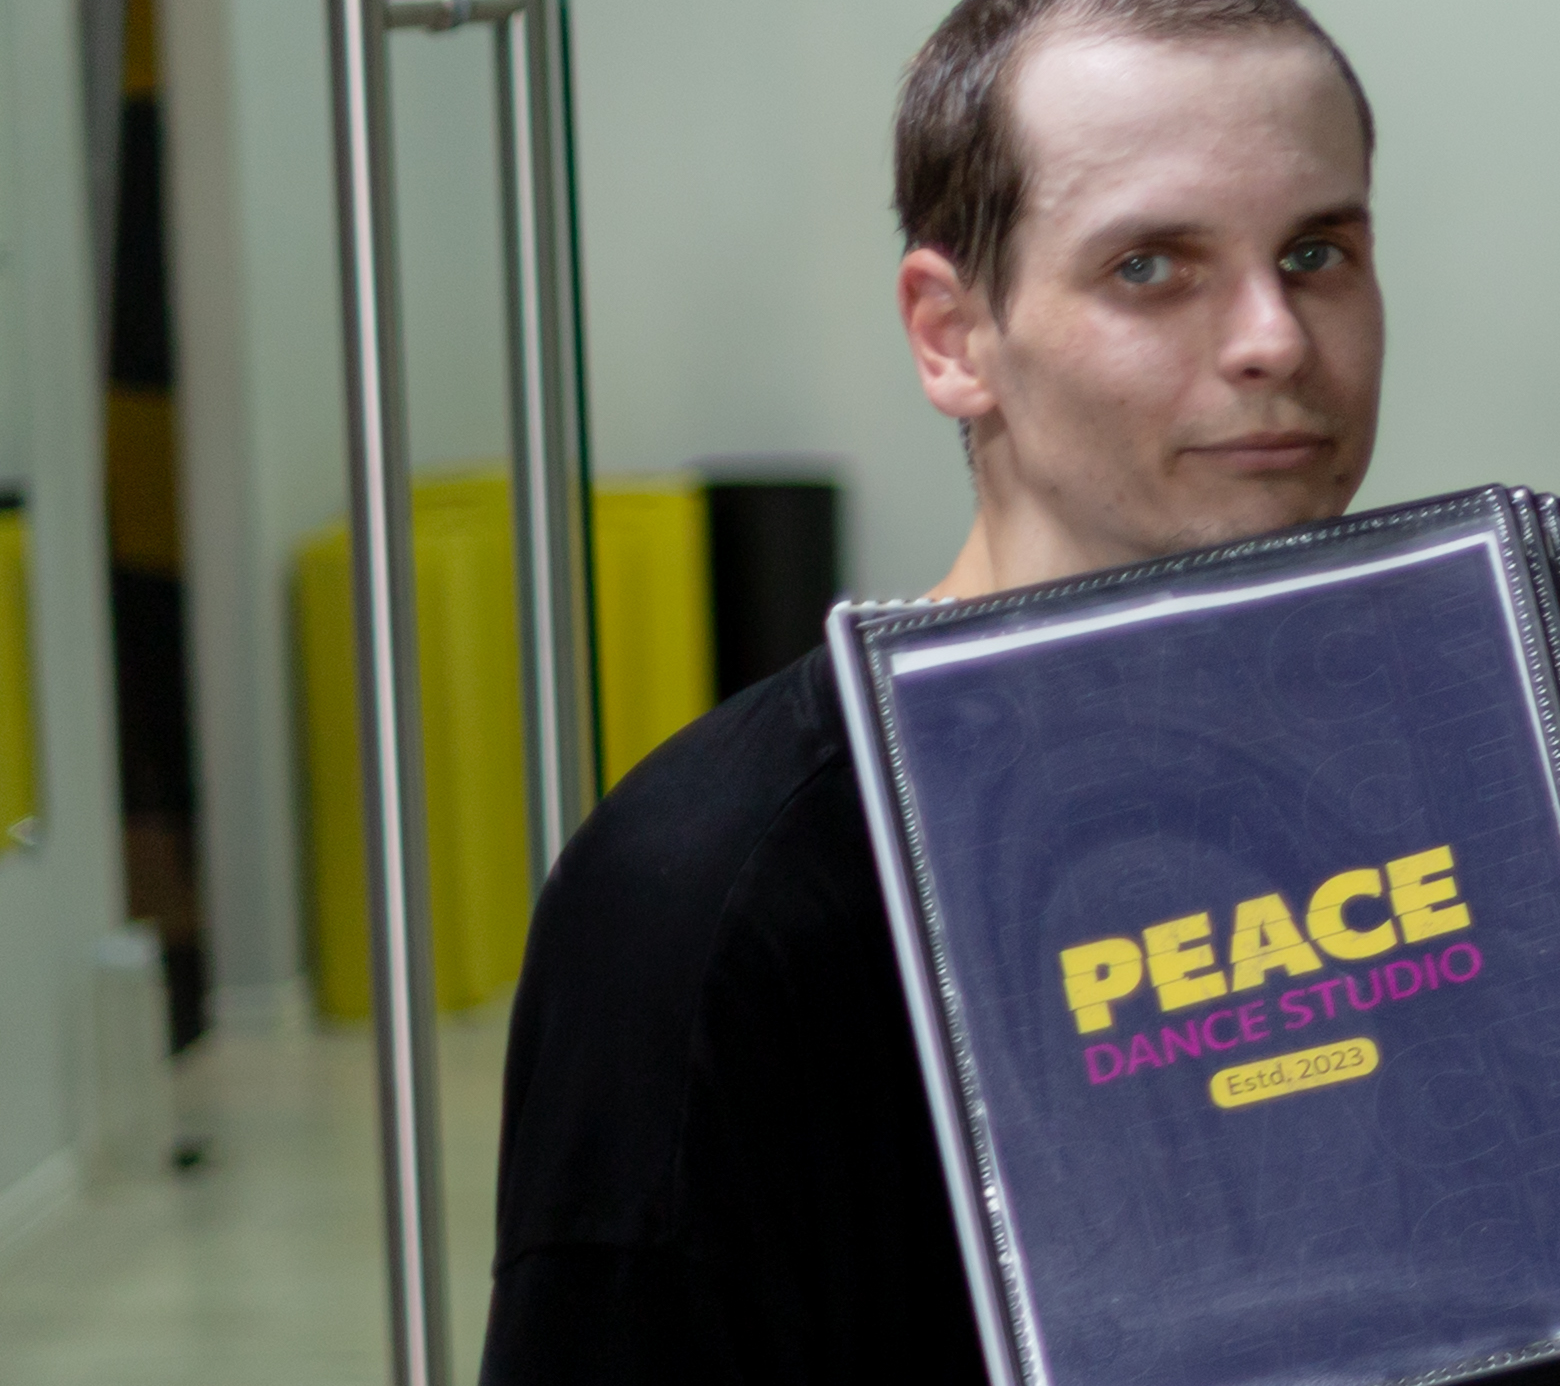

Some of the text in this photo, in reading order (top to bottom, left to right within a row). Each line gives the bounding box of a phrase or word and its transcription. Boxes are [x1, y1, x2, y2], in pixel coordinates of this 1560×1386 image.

[1058, 844, 1471, 1035] PEACE
[1083, 941, 1483, 1085] DANCE STUDIO
[1226, 1045, 1366, 1097] Estd. 2023
